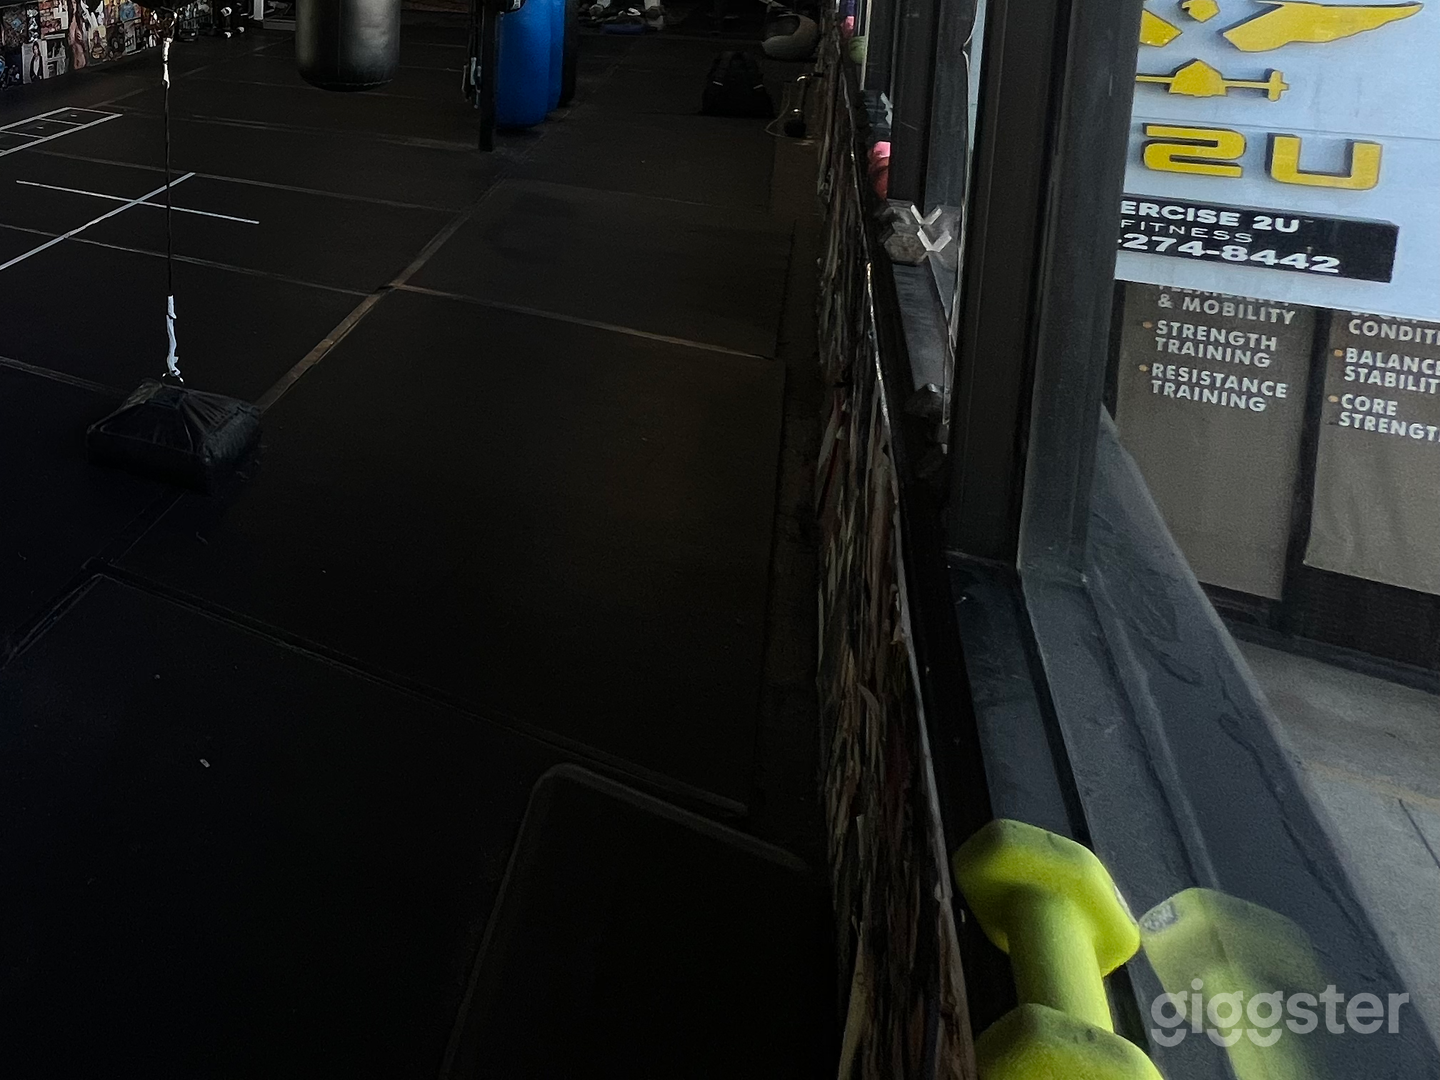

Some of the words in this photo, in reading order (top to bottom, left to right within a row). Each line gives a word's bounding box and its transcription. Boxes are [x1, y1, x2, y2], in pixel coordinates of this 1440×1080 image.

[1142, 122, 1383, 191] 2U
[1120, 219, 1253, 243] FITNESS
[1252, 215, 1300, 233] 2U
[1117, 232, 1341, 274] 274-8442
[1157, 293, 1173, 309] &
[1182, 296, 1296, 325] MOBILITY
[1155, 319, 1277, 352] STRENGTH
[1154, 336, 1273, 368] TRAINING
[1151, 362, 1290, 399] RESISTANCE
[1151, 379, 1267, 413] TRAINING
[1341, 393, 1398, 416] CORE
[1338, 411, 1440, 443] STRENGT
